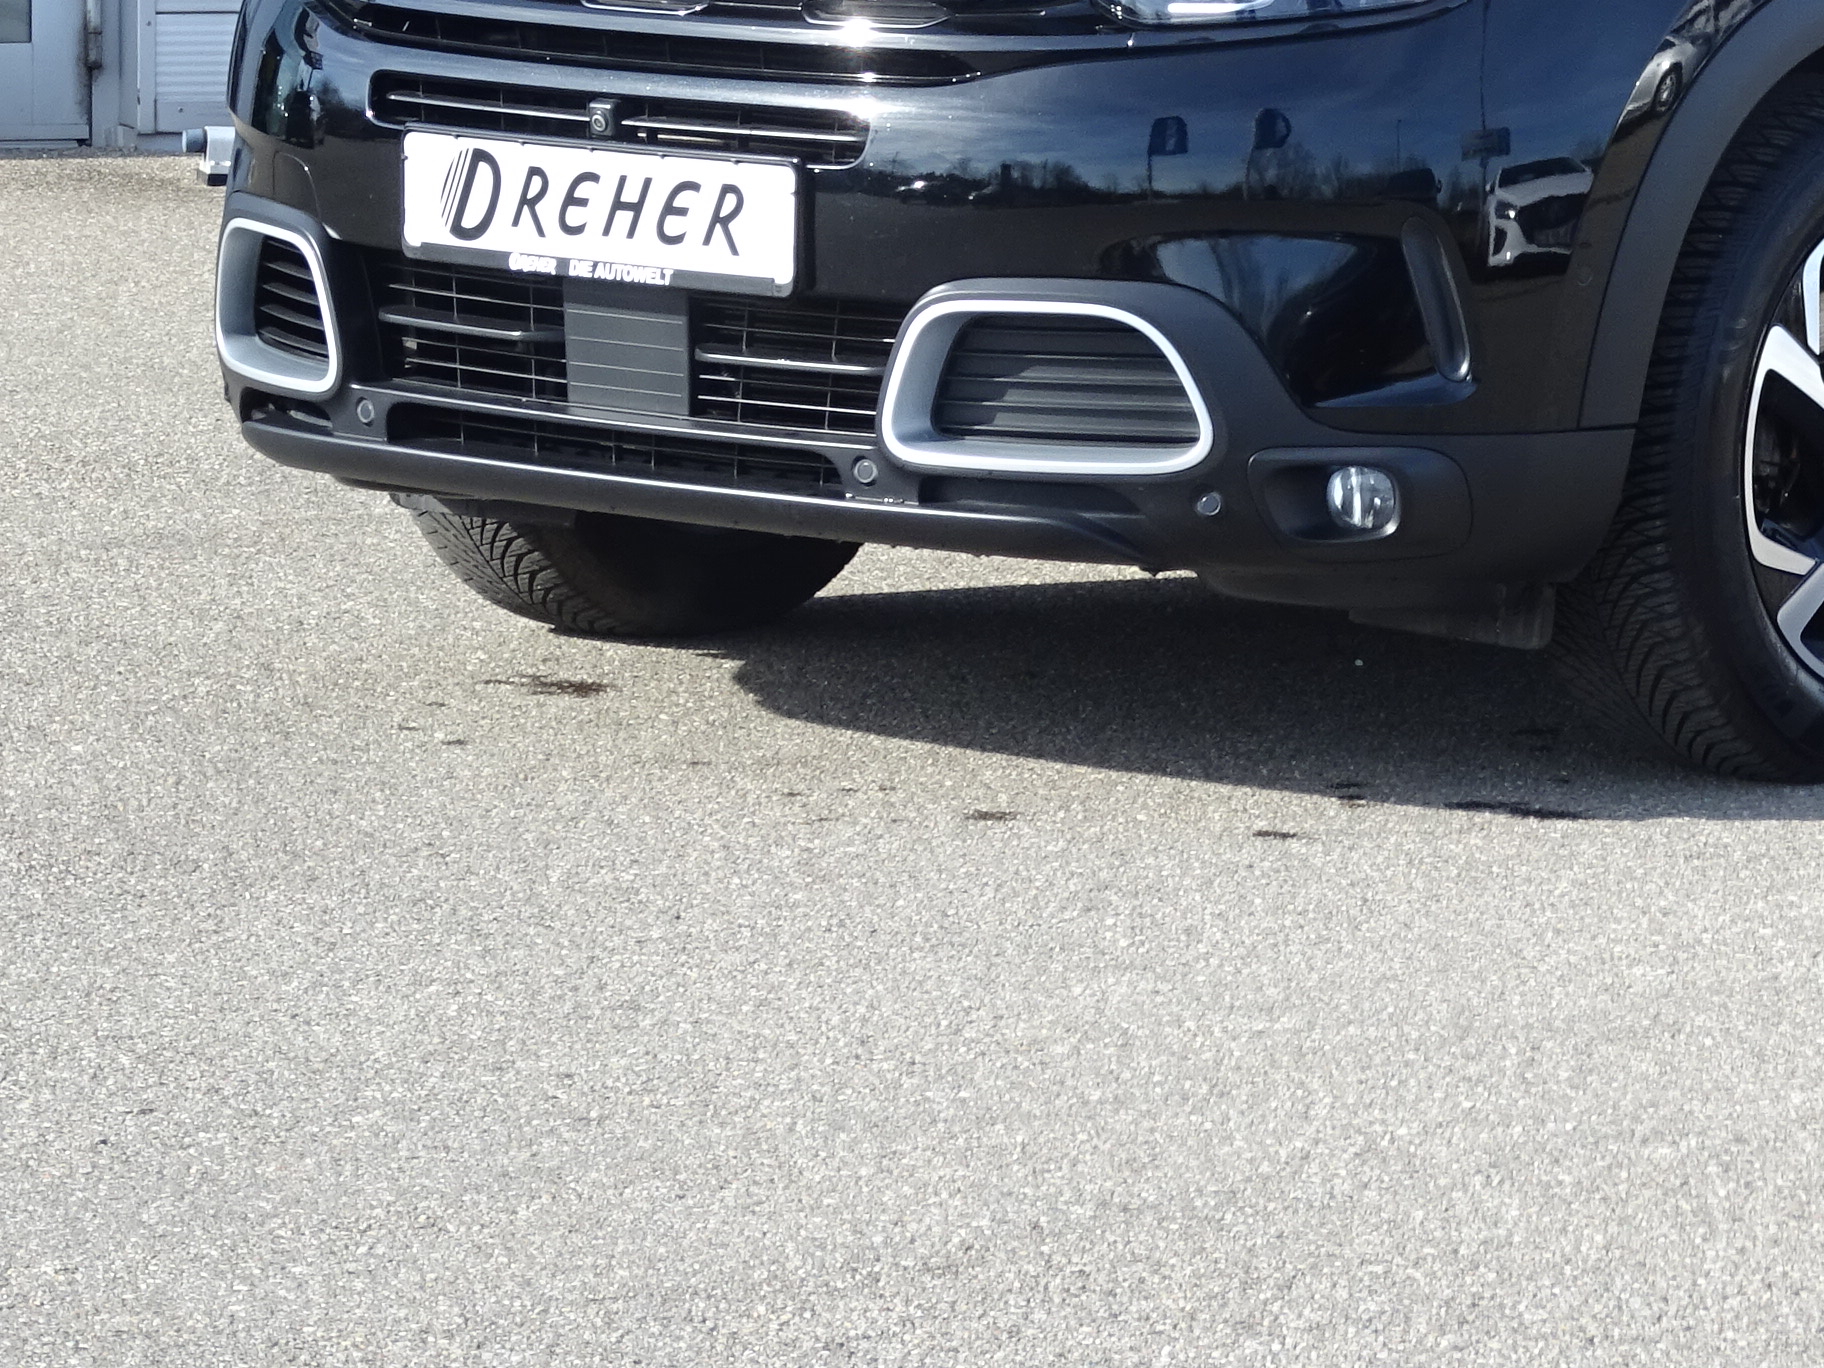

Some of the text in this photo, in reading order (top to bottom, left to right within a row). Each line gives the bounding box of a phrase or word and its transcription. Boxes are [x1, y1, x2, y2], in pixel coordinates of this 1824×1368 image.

[441, 147, 745, 257] DREHER
[568, 258, 593, 279] DIE
[594, 261, 674, 286] AUTOWELT
